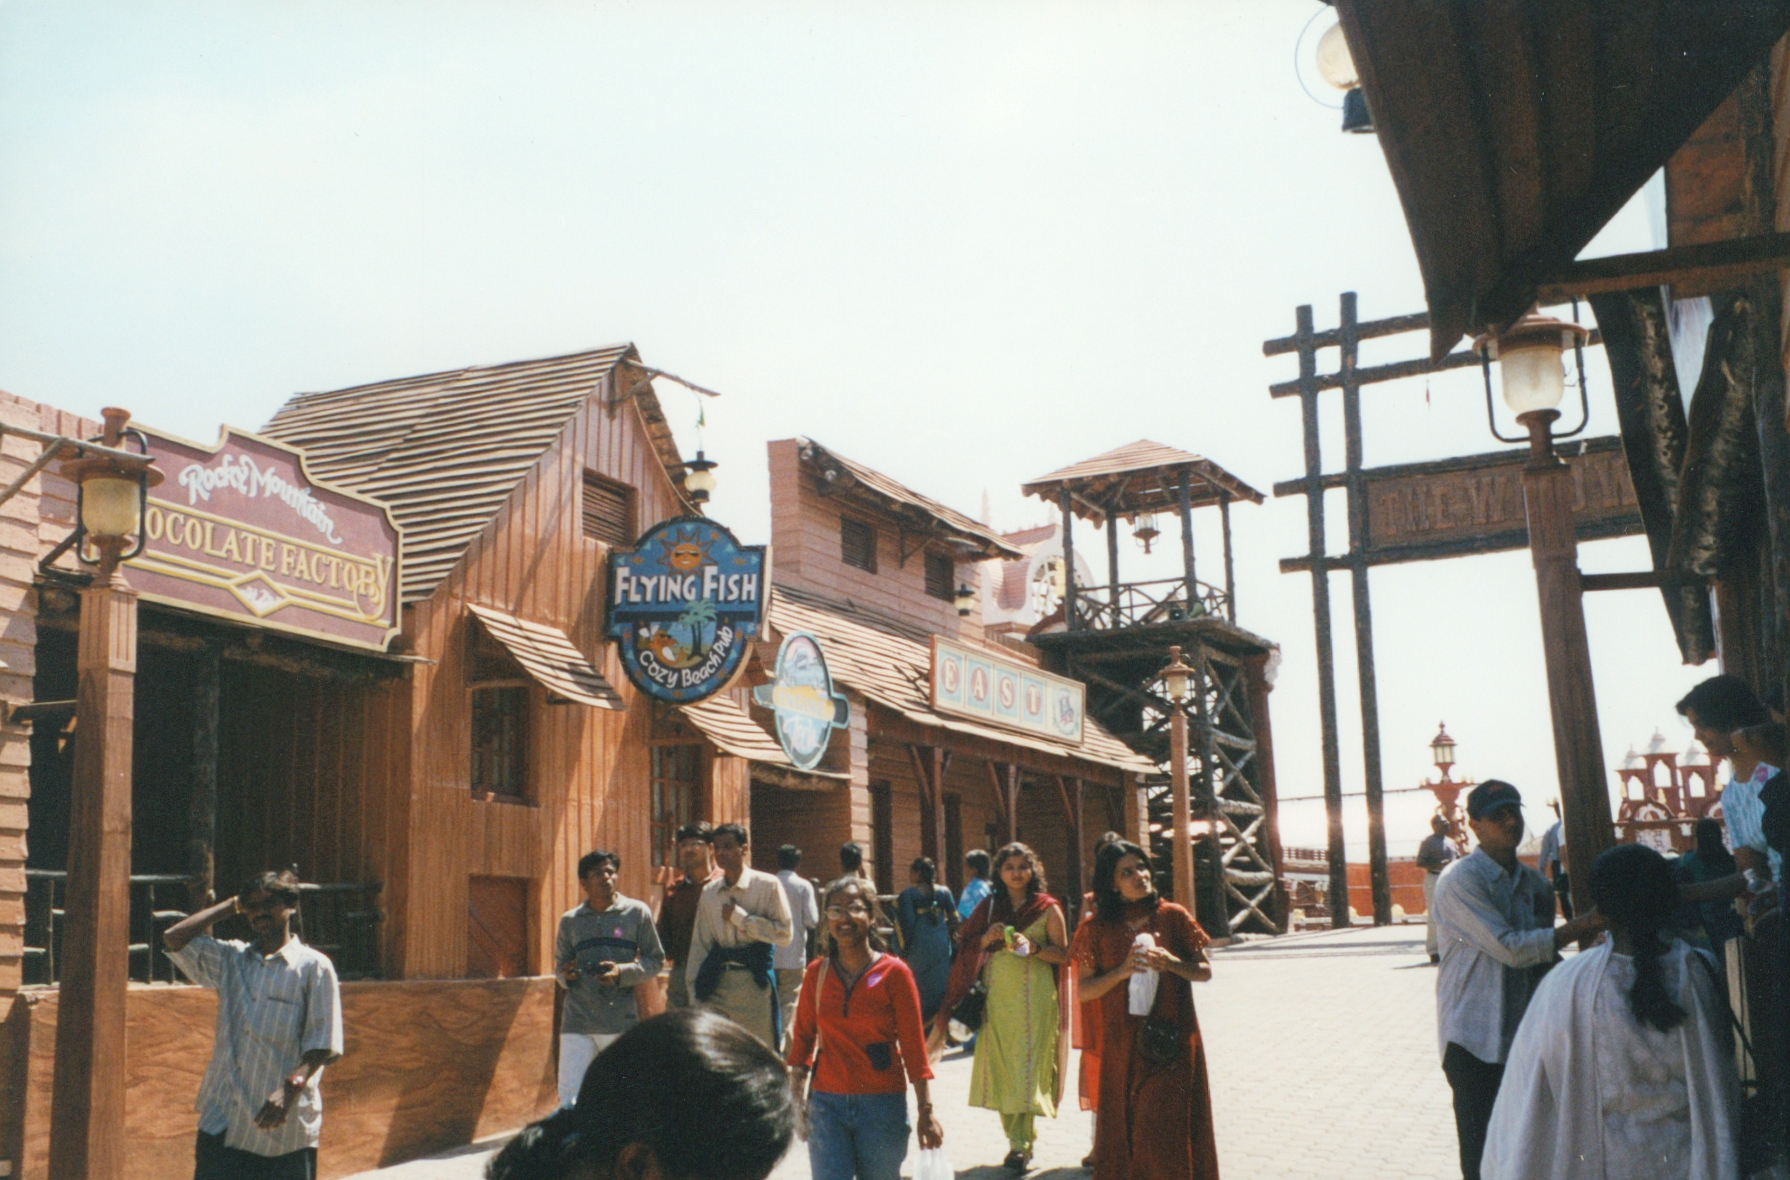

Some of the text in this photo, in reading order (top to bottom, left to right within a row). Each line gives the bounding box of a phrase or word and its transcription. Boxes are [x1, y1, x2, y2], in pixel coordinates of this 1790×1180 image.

[178, 453, 343, 545] Rocky Mountain
[1380, 485, 1456, 535] THE
[136, 507, 394, 621] OCOLATE FACTORY
[614, 565, 758, 605] FLYING FISH
[639, 650, 679, 689] Cozy
[681, 651, 722, 688] Beach
[944, 657, 1039, 714] EAST
